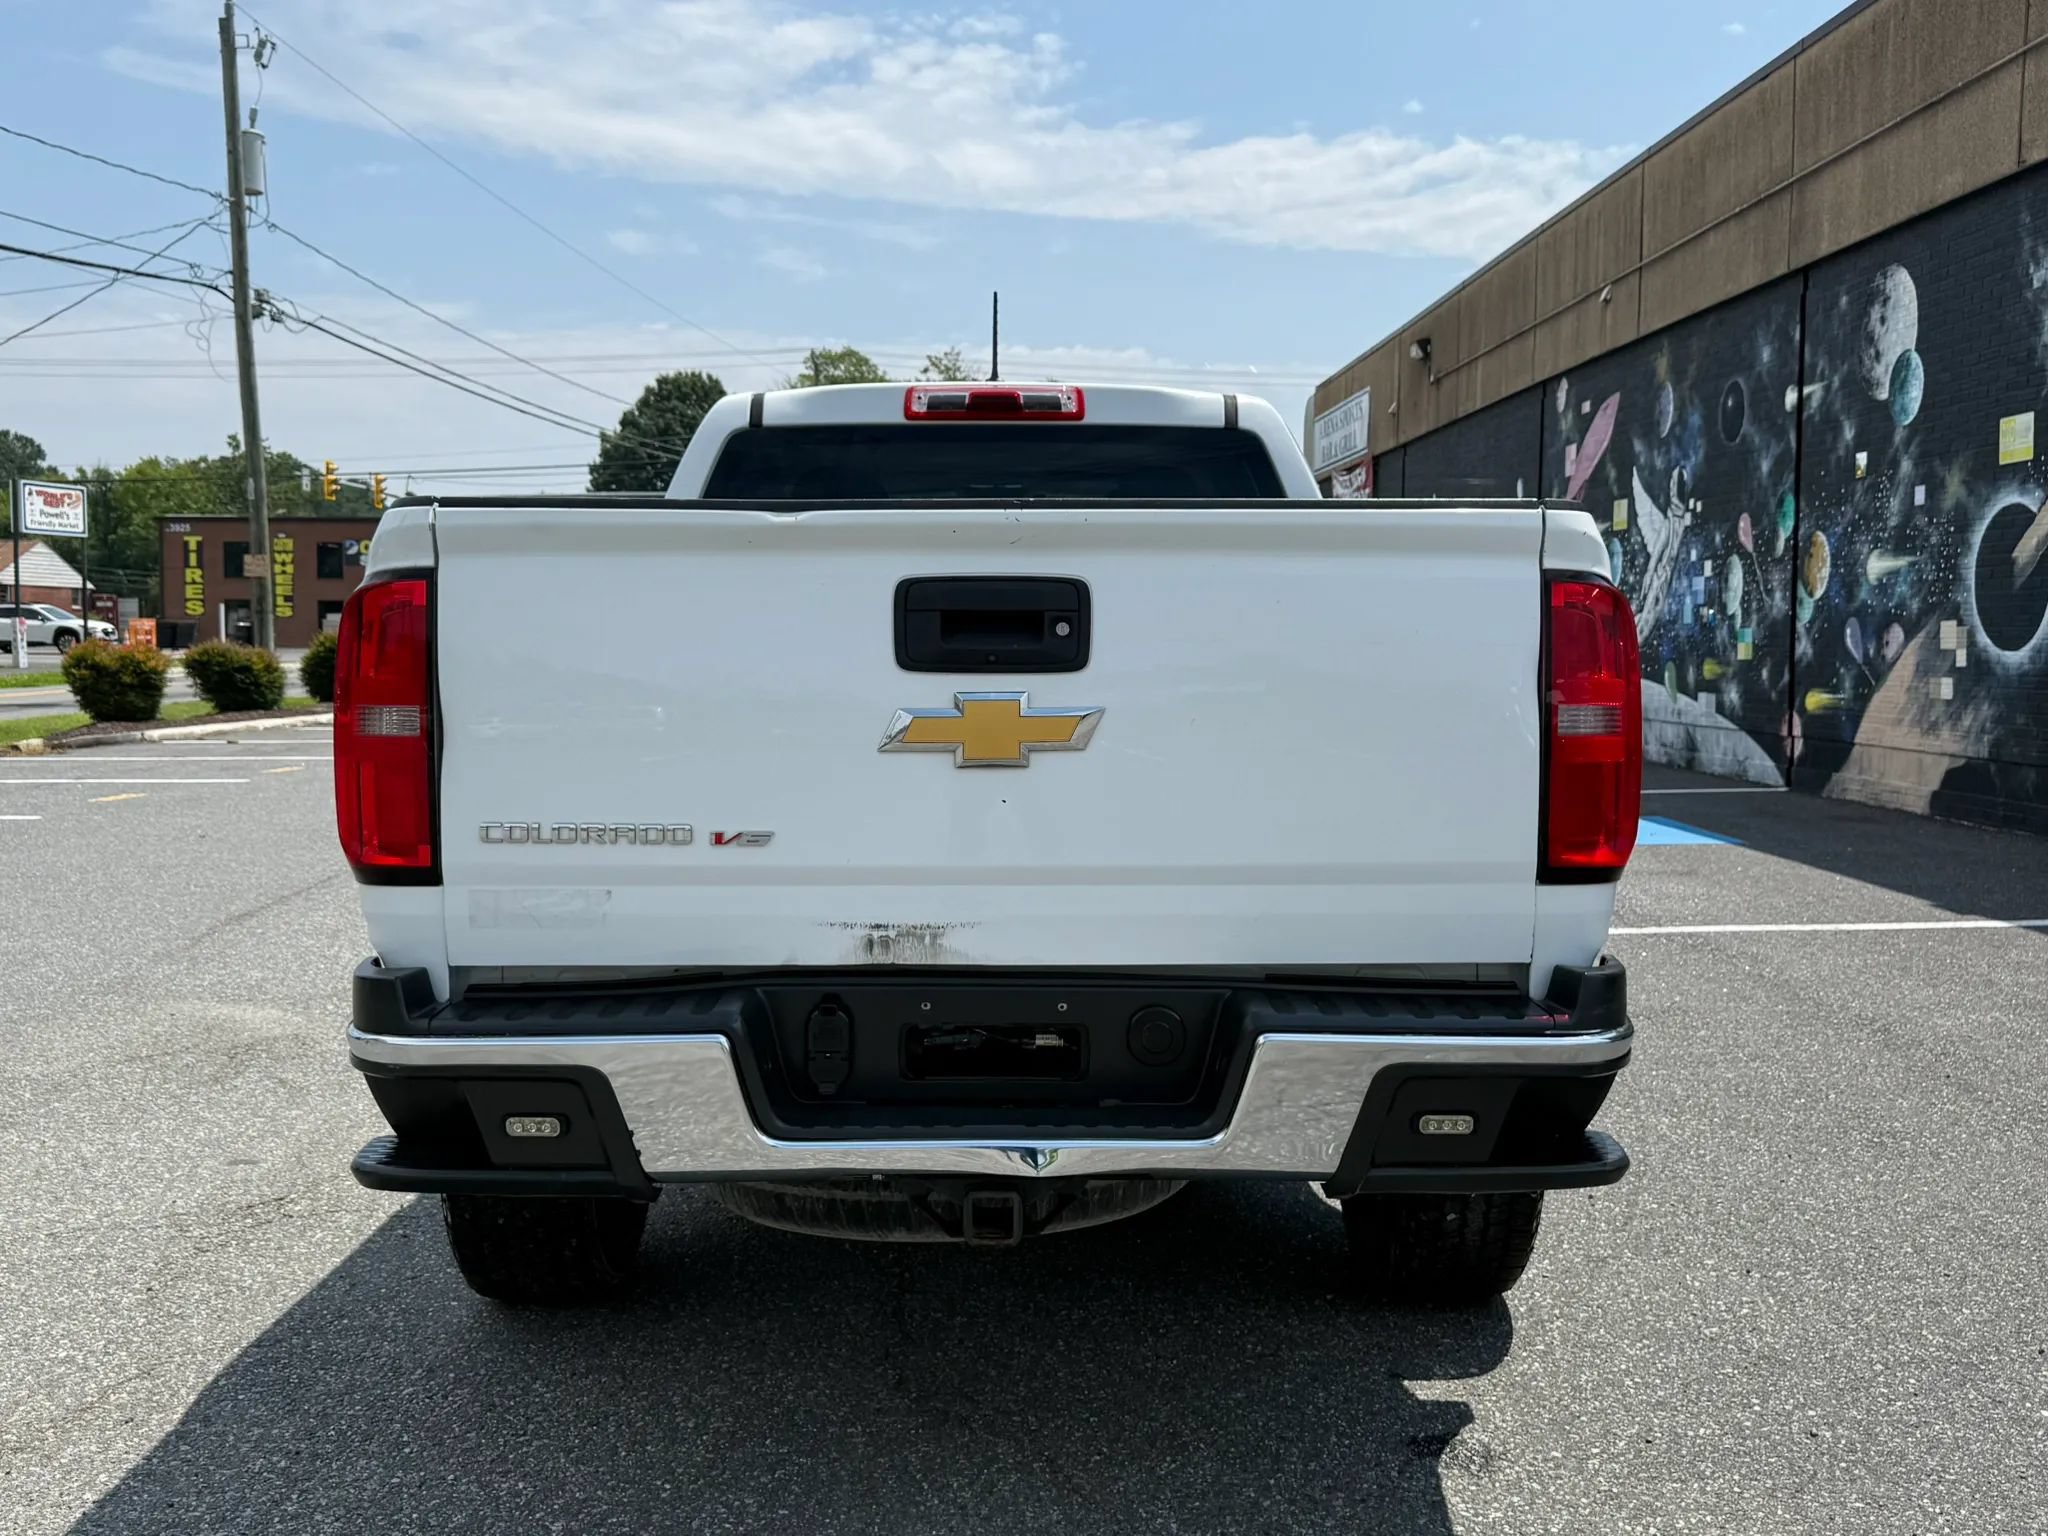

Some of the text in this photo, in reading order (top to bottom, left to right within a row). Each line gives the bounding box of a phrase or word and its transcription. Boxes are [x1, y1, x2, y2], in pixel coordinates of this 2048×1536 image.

[1340, 429, 1357, 455] GRILL
[35, 489, 73, 500] WORLD'S
[43, 498, 65, 508] BEST
[40, 509, 70, 520] Powell's
[30, 519, 80, 529] Friendly Market
[184, 535, 205, 616] TIRES
[274, 552, 294, 617] WHEELS
[480, 822, 775, 847] COLORADO V6
